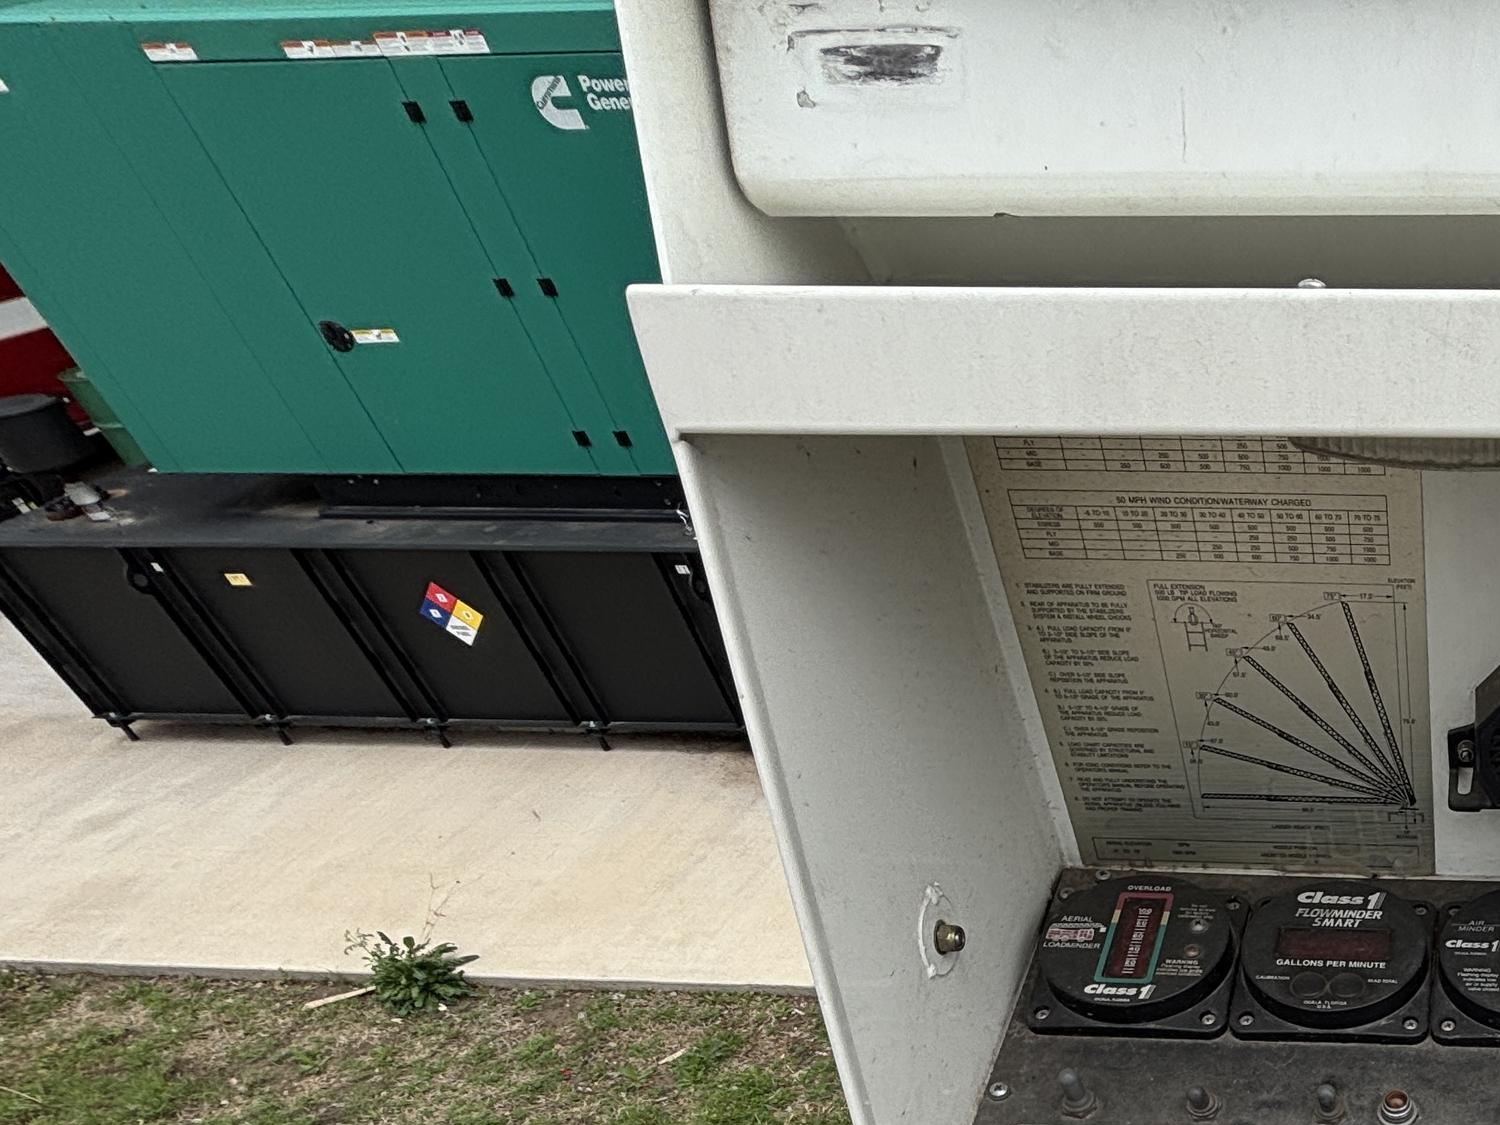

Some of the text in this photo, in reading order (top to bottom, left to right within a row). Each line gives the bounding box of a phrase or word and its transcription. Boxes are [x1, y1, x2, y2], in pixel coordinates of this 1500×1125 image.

[586, 93, 632, 111] Gene
[1129, 497, 1147, 505] MPH
[1149, 497, 1172, 505] WIND
[1271, 499, 1311, 507] CHARGED
[1127, 884, 1172, 892] OVERLOAD
[1061, 915, 1094, 923] AERIAL
[1295, 907, 1383, 920] FLOWMINDER
[1312, 917, 1362, 928] SMART
[1276, 958, 1387, 969] GALLONS PER MINUTE
